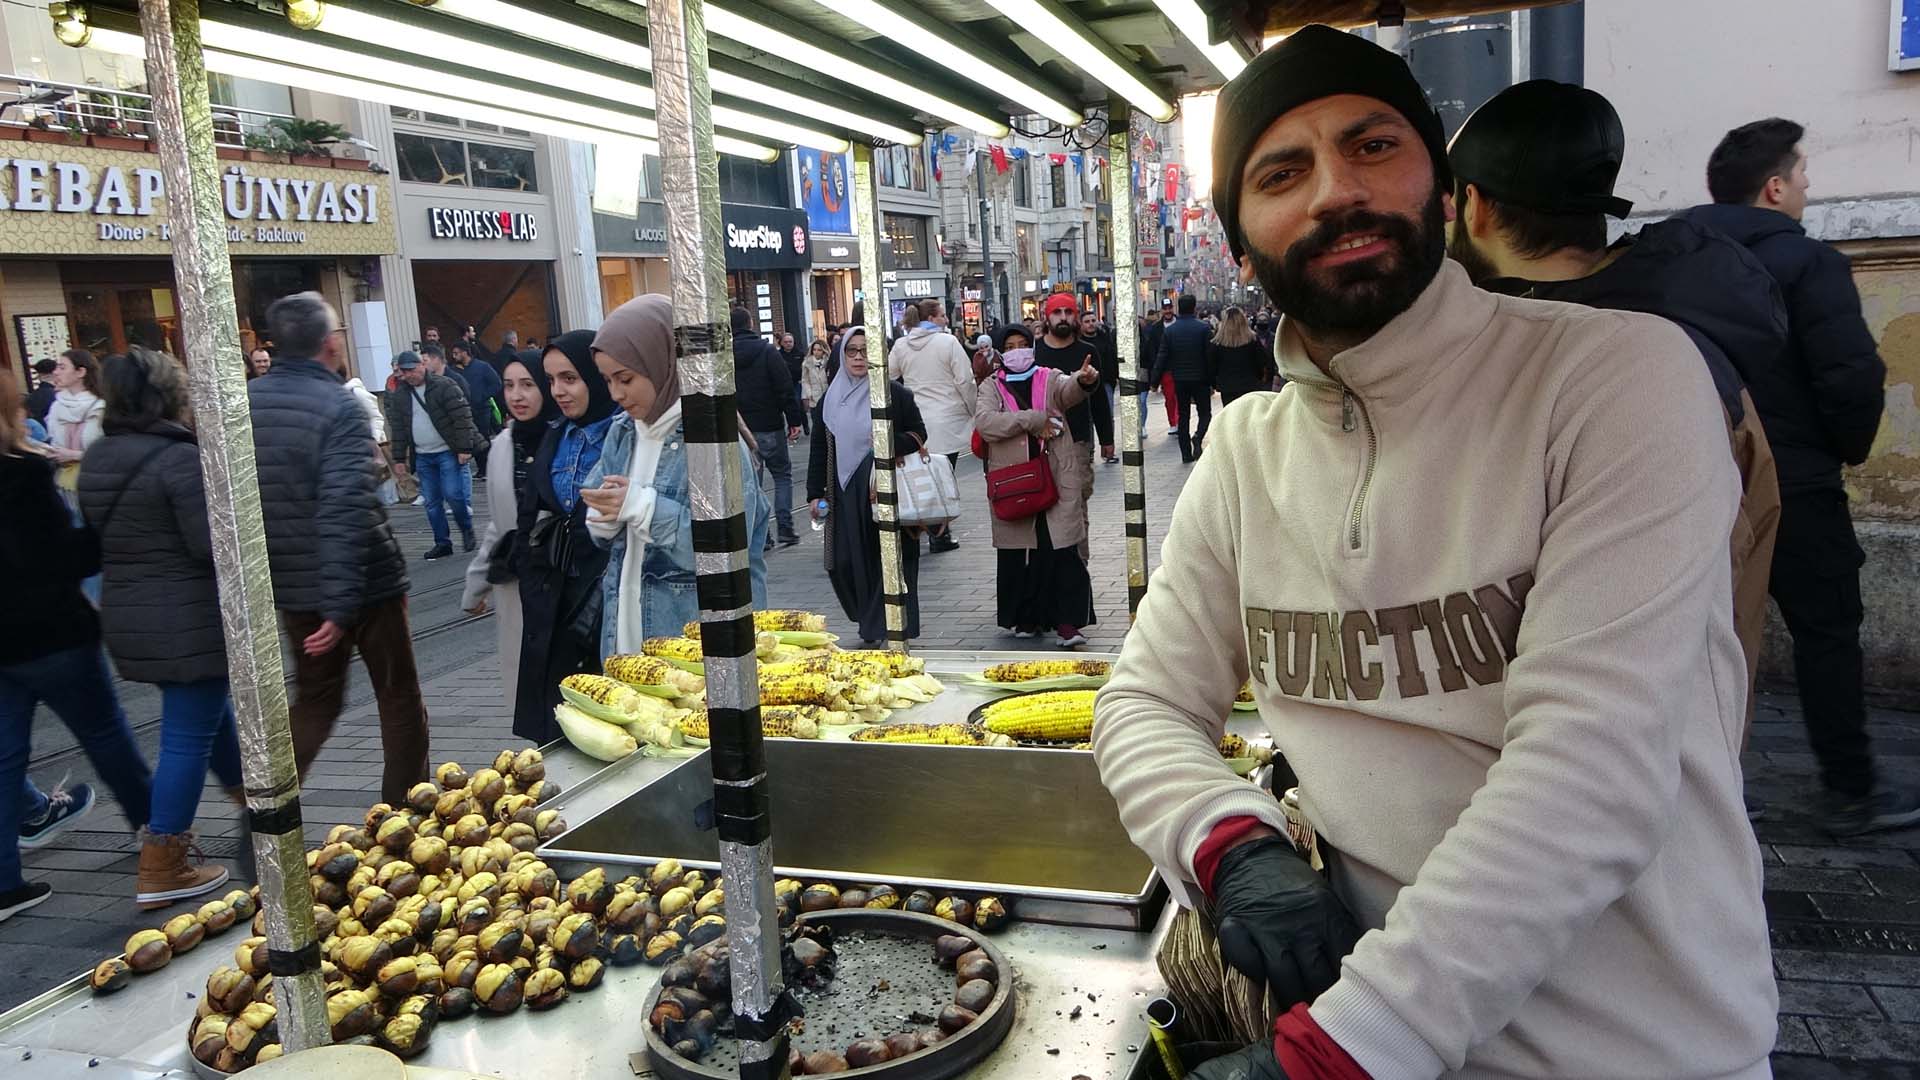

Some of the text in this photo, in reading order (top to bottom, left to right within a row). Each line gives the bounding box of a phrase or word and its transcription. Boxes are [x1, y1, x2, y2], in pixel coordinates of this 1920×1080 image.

[0, 158, 378, 223] EBAP ÜNYASI
[100, 224, 147, 241] Döner
[227, 227, 247, 242] ide
[256, 228, 306, 243] Baklava
[634, 229, 668, 241] LACOST
[727, 223, 782, 253] SuperStep
[904, 280, 931, 296] GUESS
[1246, 571, 1536, 701] FUNCTION
